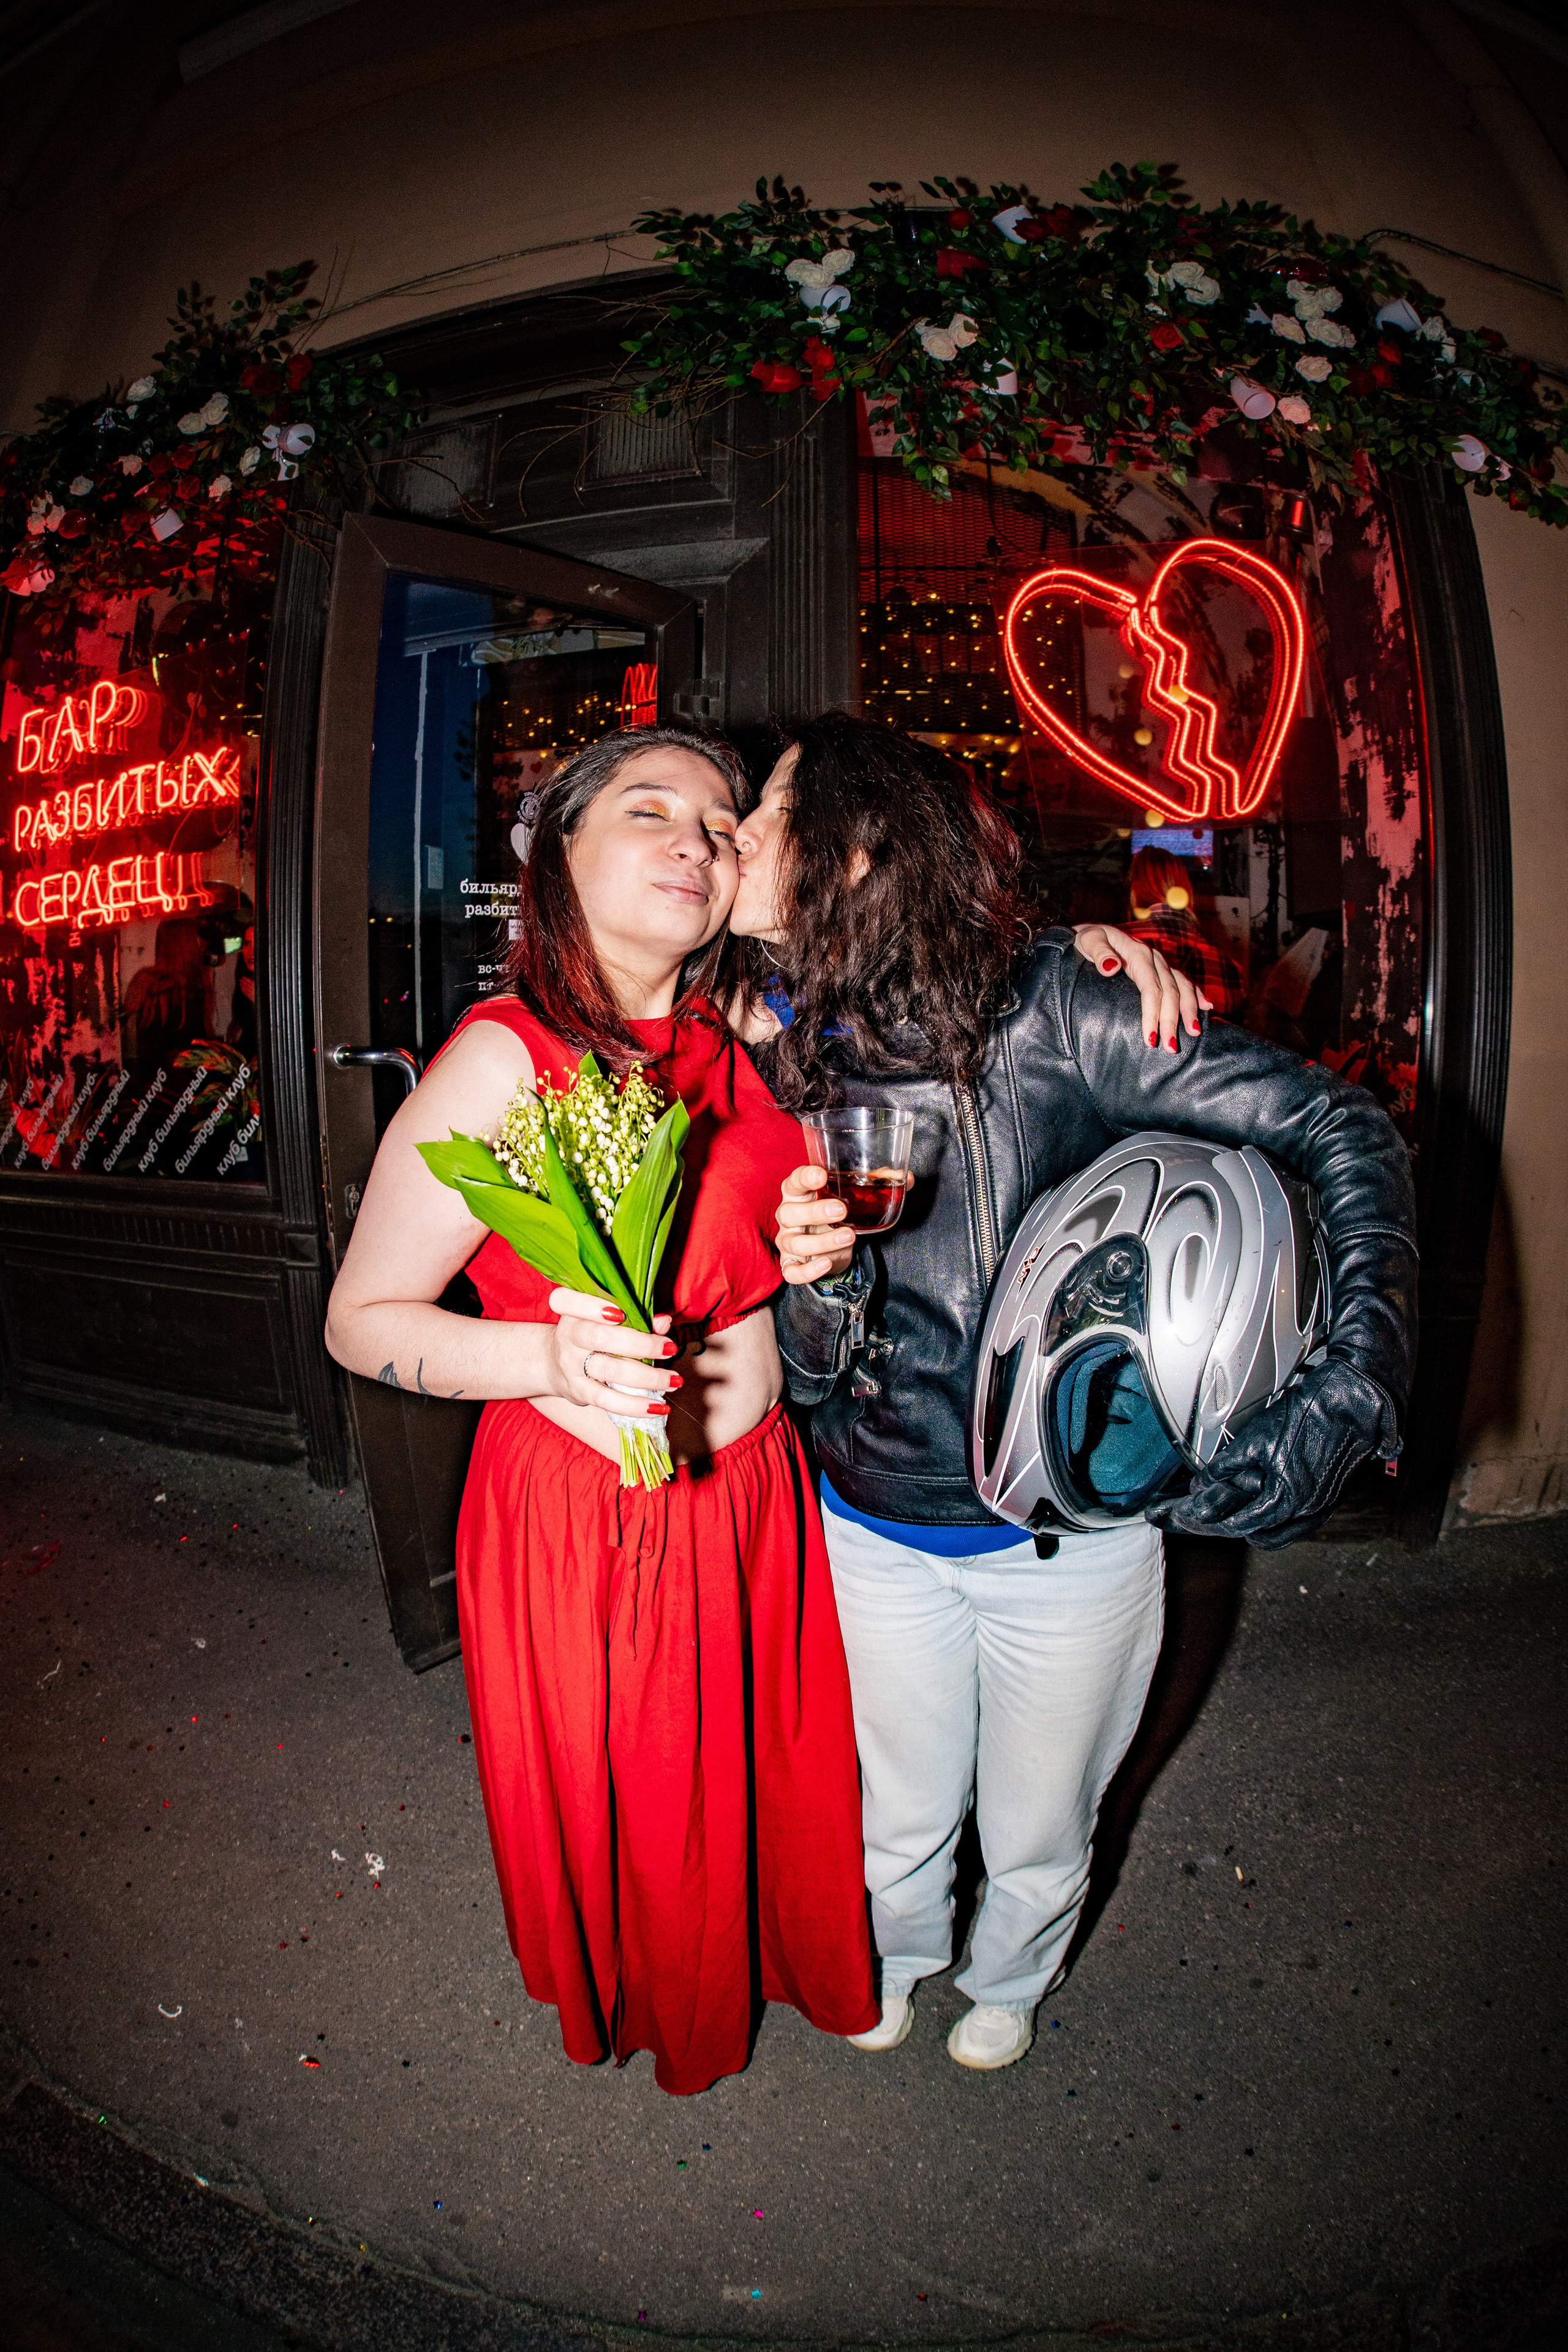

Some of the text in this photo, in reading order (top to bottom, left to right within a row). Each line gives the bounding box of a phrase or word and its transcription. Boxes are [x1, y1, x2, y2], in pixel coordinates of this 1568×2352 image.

[18, 680, 116, 773] БАР
[14, 747, 227, 852] РАЗБИТЫХ
[15, 851, 173, 929] СЕРДЕЦ
[465, 902, 521, 918] разбит
[71, 1069, 131, 1170] клуб бильярдный
[77, 1072, 96, 1106] клуб
[103, 1067, 167, 1172] бильярдный клуб
[138, 1065, 208, 1173] клуб бильярдный
[175, 1062, 251, 1174] бильярдный клуб
[15, 1139, 29, 1169] клуб
[216, 1139, 241, 1176] клуб
